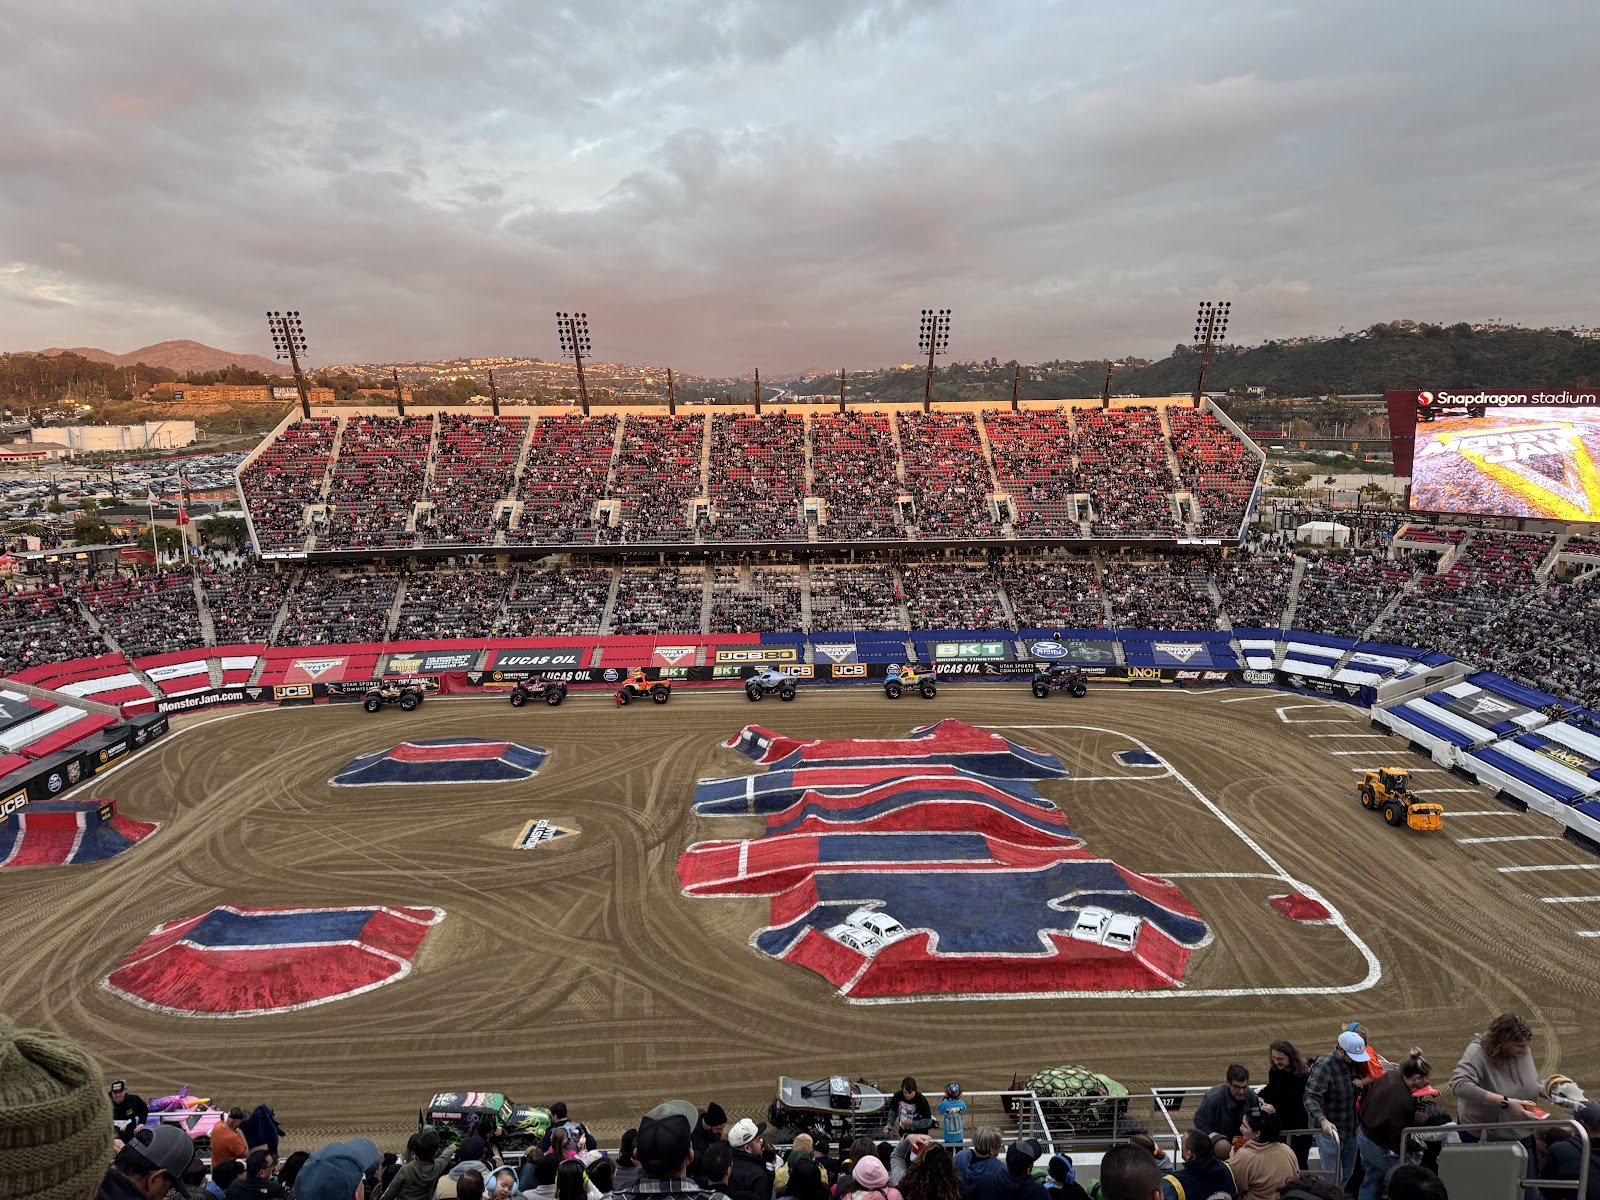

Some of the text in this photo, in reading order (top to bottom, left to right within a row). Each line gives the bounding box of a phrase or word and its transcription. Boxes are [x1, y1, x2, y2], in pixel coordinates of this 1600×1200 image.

[1437, 391, 1597, 407] Snapdragon stadium
[937, 644, 1002, 655] BKT
[498, 656, 550, 665] LUCAS
[720, 652, 763, 660] JCB
[659, 667, 687, 677] BKT
[713, 666, 741, 675] BKT
[781, 666, 812, 676] JCB
[834, 666, 865, 675] JCB
[937, 663, 963, 674] UCAS
[1127, 667, 1161, 678] UNOH
[277, 685, 310, 696] JCB
[158, 691, 244, 713] MonsterJam.com
[1010, 1102, 1021, 1110] 32
[1161, 1098, 1175, 1107] 327
